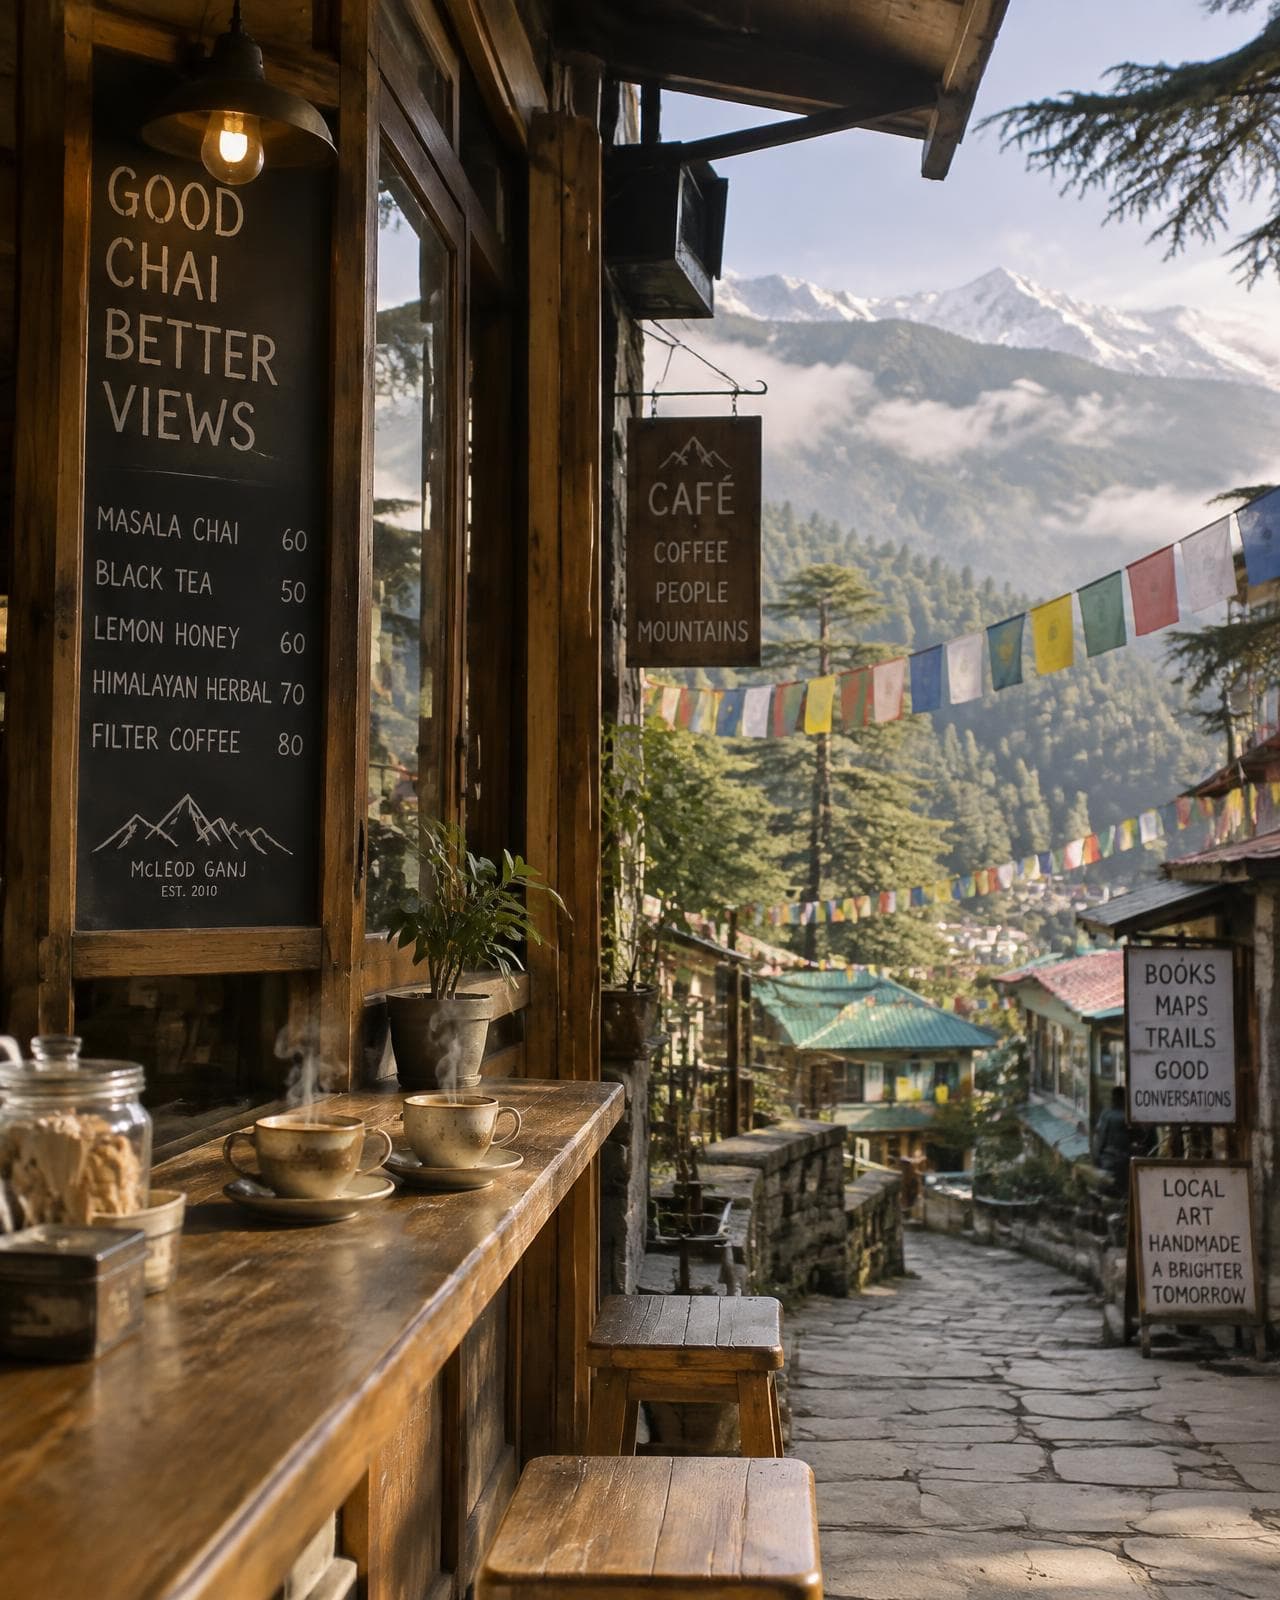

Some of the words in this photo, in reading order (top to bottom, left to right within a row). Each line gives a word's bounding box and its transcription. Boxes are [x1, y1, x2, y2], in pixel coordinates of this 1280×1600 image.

[107, 165, 244, 236] GOOD
[105, 236, 218, 302] CHAI
[105, 307, 278, 385] BETTER
[102, 380, 256, 450] VIEWS
[648, 474, 735, 516] CAFÉ
[97, 505, 182, 539] MASALA
[193, 517, 239, 545] CHAI
[281, 528, 308, 551] 60
[653, 540, 729, 564] COFFEE
[96, 559, 163, 591] BLACK
[174, 568, 213, 595] TEA
[280, 579, 306, 603] 50
[655, 581, 729, 603] PEOPLE
[94, 615, 164, 644] LEMON
[175, 622, 240, 649] HONEY
[280, 631, 306, 654] 60
[637, 620, 750, 643] MOUNTAINS
[93, 669, 198, 699] HIMALAYAN
[206, 677, 272, 704] HERBAL
[280, 682, 305, 705] 70
[92, 722, 159, 750] FILTER
[169, 727, 241, 754] COFFEE
[278, 732, 304, 756] 80
[131, 861, 195, 878] McLEOD
[205, 861, 246, 878] GANJ
[161, 885, 186, 898] EST.
[191, 885, 218, 897] 2010
[1145, 963, 1216, 985] BOOKS
[1156, 995, 1208, 1017] MAPS
[1145, 1027, 1216, 1049] TRAILS
[1155, 1060, 1209, 1080] GOOD
[1135, 1089, 1232, 1108] CONVERSATIONS
[1163, 1178, 1225, 1198] LOCAL
[1176, 1206, 1213, 1226] ART
[1149, 1234, 1241, 1254] HANDMADE
[1152, 1261, 1162, 1278] A
[1169, 1261, 1243, 1280] BRIGHTER
[1152, 1285, 1246, 1304] TOMORROW
